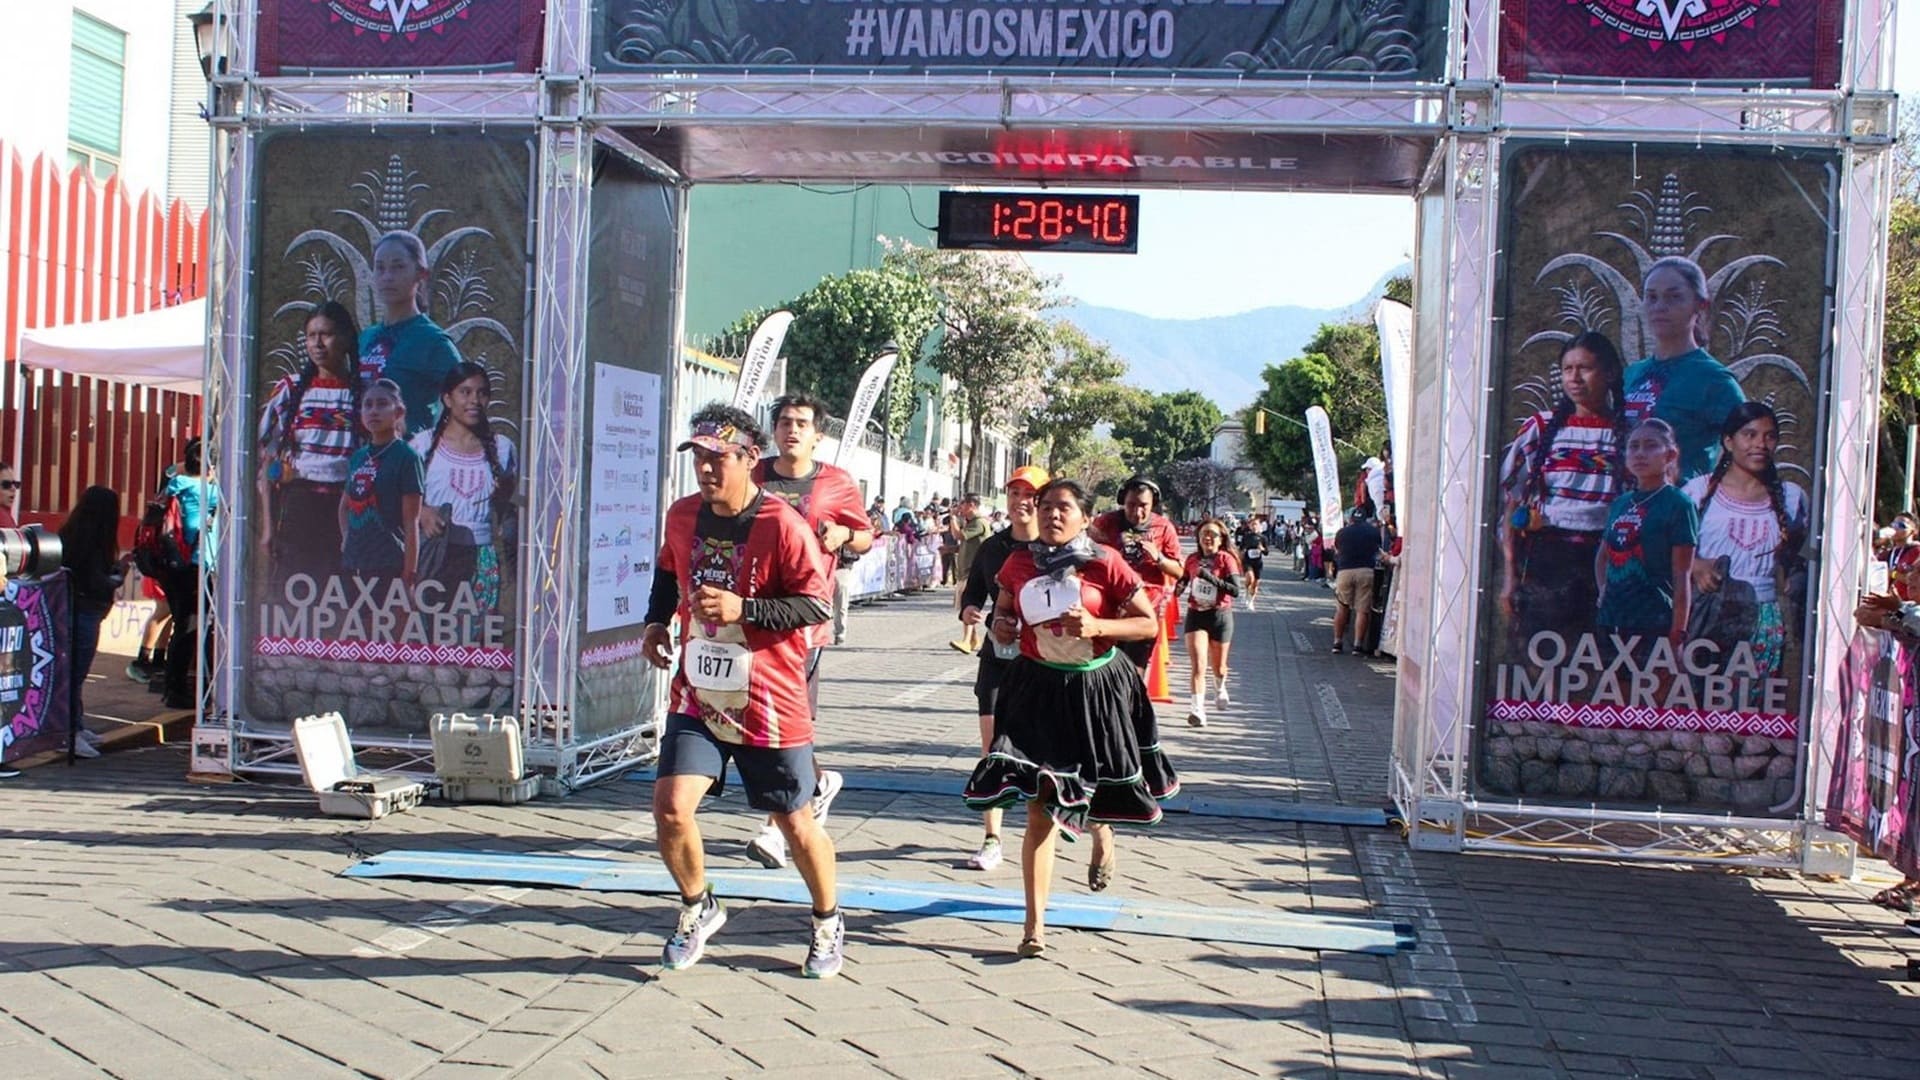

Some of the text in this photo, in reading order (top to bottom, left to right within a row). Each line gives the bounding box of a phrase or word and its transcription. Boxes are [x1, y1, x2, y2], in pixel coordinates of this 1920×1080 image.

[846, 8, 1175, 59] #VAMOSMEXICO
[771, 150, 1299, 171] #MEXICOIMPARABLE
[993, 200, 1128, 242] 1:28:40
[284, 572, 480, 617] OAXACA
[1044, 588, 1051, 608] 1
[260, 603, 505, 649] IMPARABLE
[697, 654, 734, 678] 1877
[1527, 629, 1761, 679] OAXACA
[1496, 663, 1789, 715] IMPARABLE
